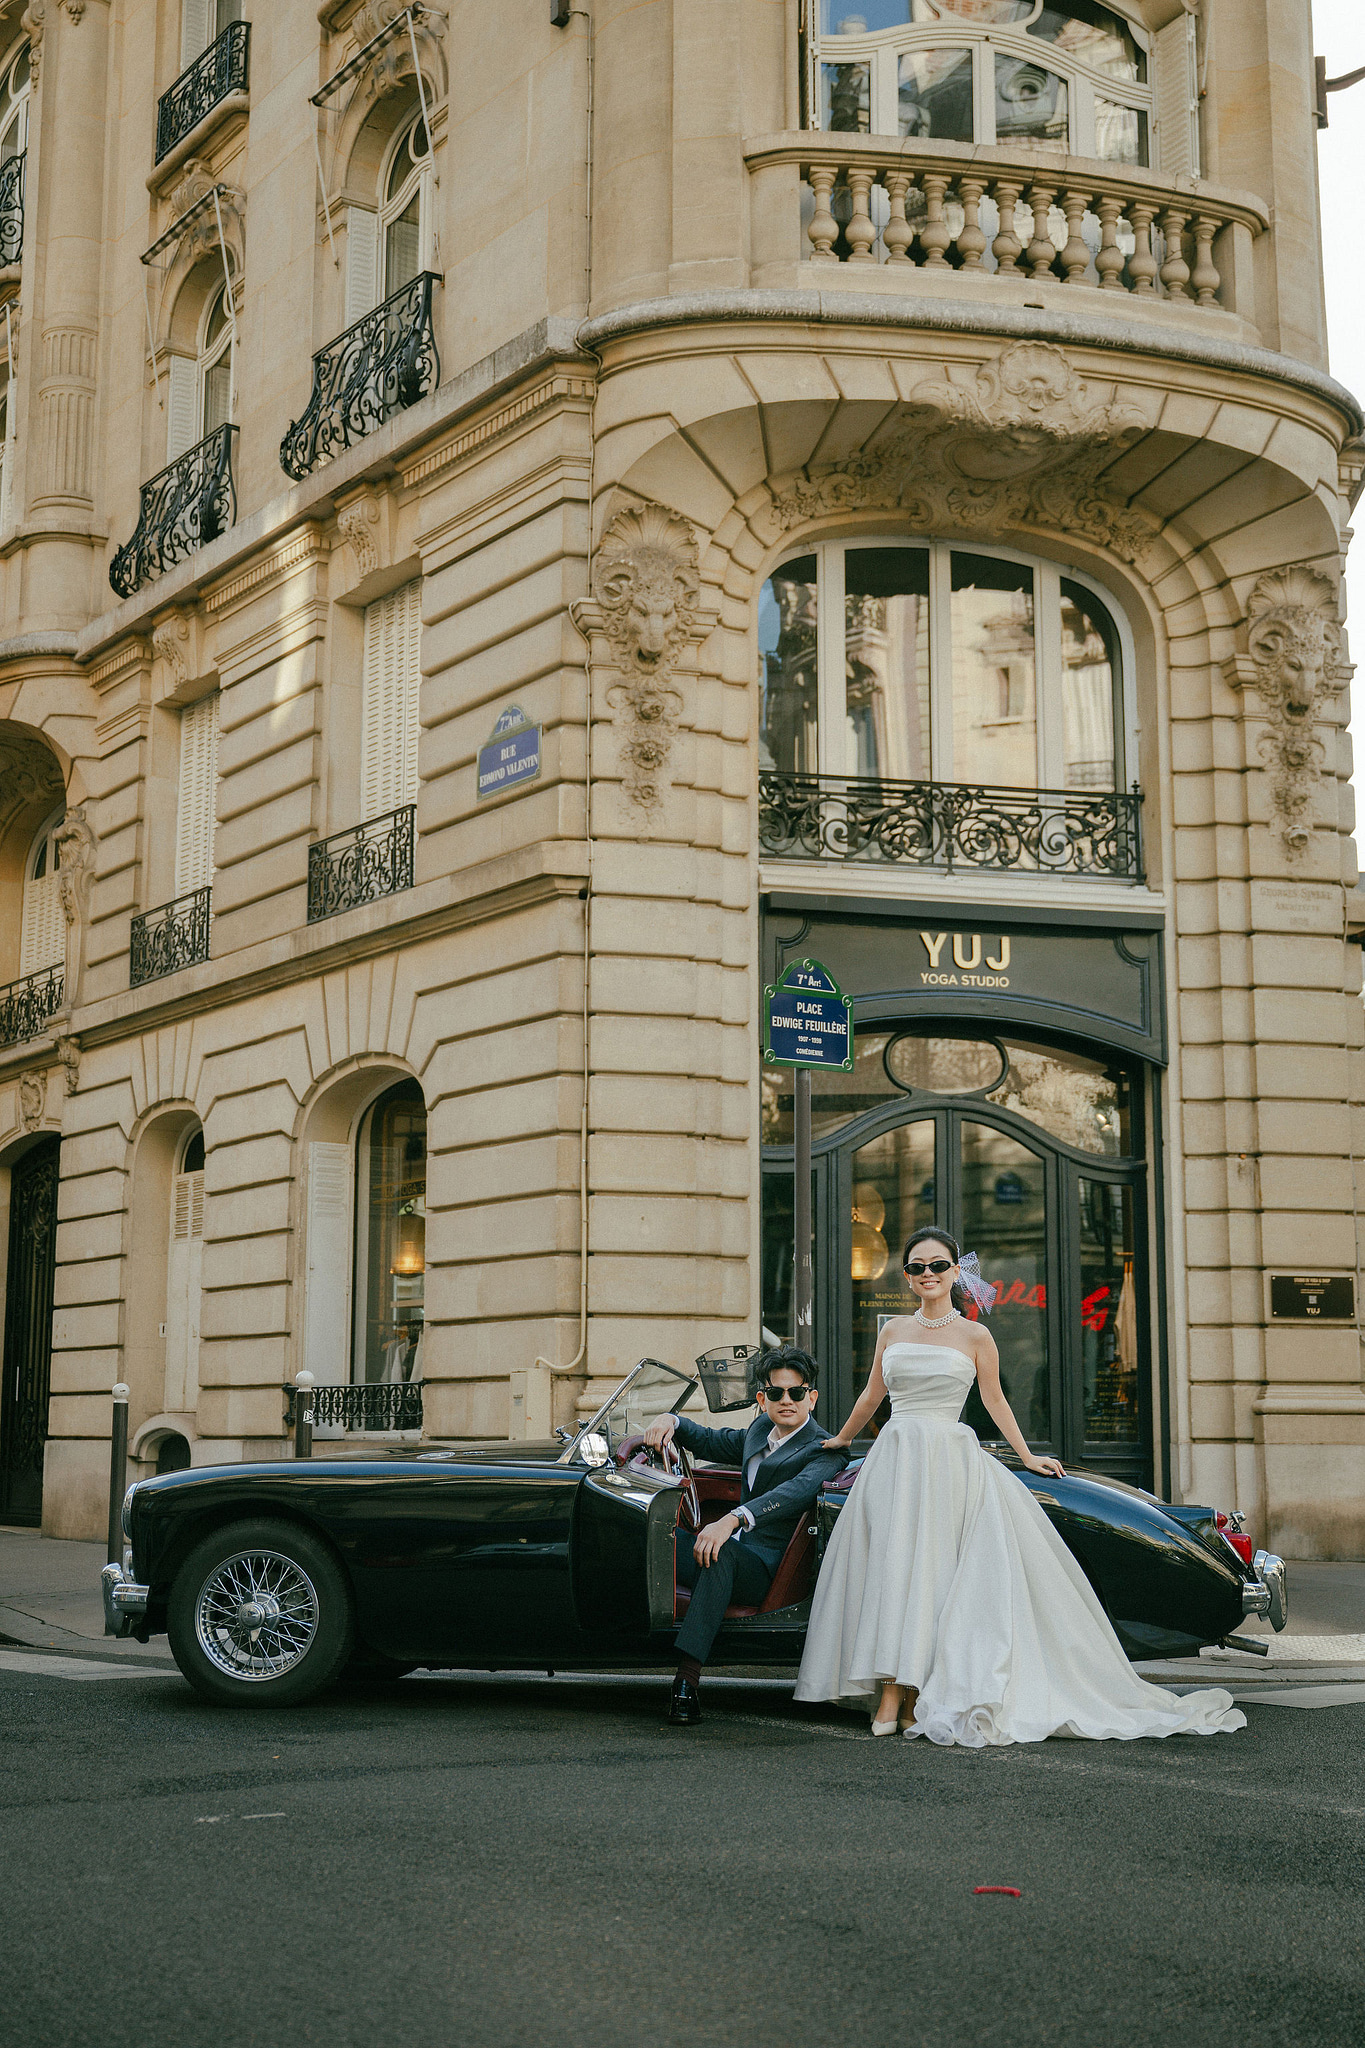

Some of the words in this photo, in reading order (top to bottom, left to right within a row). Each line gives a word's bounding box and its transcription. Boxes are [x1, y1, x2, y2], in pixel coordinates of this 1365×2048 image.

[501, 744, 516, 761] RUE
[480, 767, 505, 788] EDMOND
[506, 753, 539, 776] VALENTIN
[920, 931, 1010, 971] YUJ
[920, 972, 958, 985] YOGA
[961, 974, 1010, 988] STUDIO
[797, 1001, 823, 1015] PLACE
[771, 1015, 804, 1030] EDWIGE
[805, 1019, 847, 1035] FEUILLÈRE
[875, 1292, 901, 1300] MAISON
[859, 1300, 884, 1308] PLEINE
[885, 1301, 922, 1309] CONSCIEN
